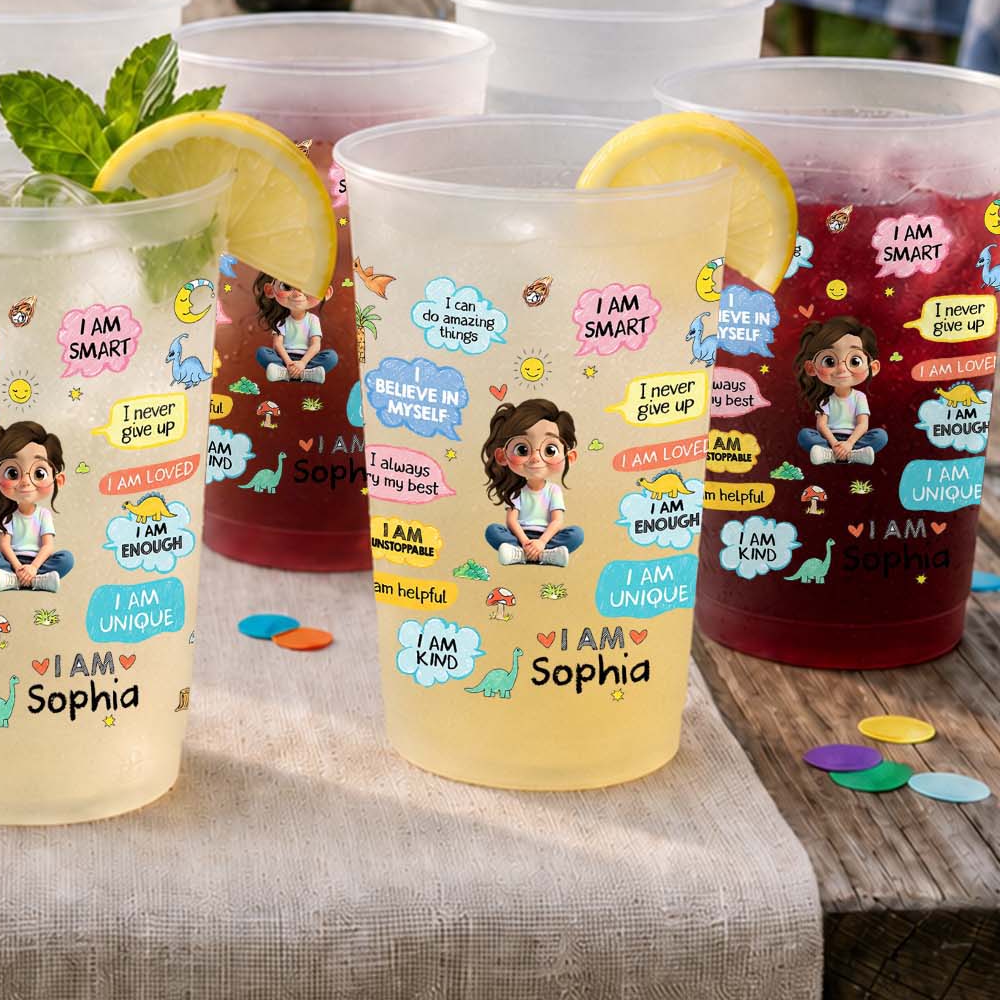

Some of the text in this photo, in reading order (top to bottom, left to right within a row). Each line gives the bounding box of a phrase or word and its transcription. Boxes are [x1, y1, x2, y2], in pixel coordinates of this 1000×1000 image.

[893, 224, 933, 242] I AM
[883, 243, 943, 263] SMART
[728, 293, 734, 307] I
[935, 302, 986, 318] I never
[80, 316, 121, 336] I AM
[718, 309, 770, 326] IEVE IN
[932, 317, 985, 337] give up
[716, 326, 760, 342] YSELF
[69, 337, 132, 360] SMART
[640, 381, 696, 400] I never
[123, 403, 176, 422] I never
[636, 398, 695, 422] give up
[121, 421, 176, 445] give up
[207, 440, 232, 456] AM
[318, 436, 324, 454] I
[208, 454, 233, 470] IND
[370, 451, 430, 478] I always
[622, 454, 626, 468] I
[631, 451, 658, 468] AM
[107, 461, 194, 491] I AM LOVED
[294, 458, 367, 490] Soph
[366, 472, 440, 496] ry my best
[926, 465, 970, 483] I AM
[912, 484, 982, 504] UNIQUE
[650, 499, 684, 515] I AM
[136, 522, 168, 538] I AM
[634, 512, 700, 534] ENOUGH
[121, 535, 183, 558] ENOUGH
[739, 531, 776, 547] I AM
[738, 546, 777, 562] KIND
[626, 565, 674, 585] I AM
[114, 589, 160, 610] I AM
[373, 582, 448, 604] am helpful
[609, 584, 689, 608] UNIQUE
[99, 608, 174, 633] UNIQUE
[54, 652, 115, 677] I AM
[27, 678, 139, 722] Sophia
